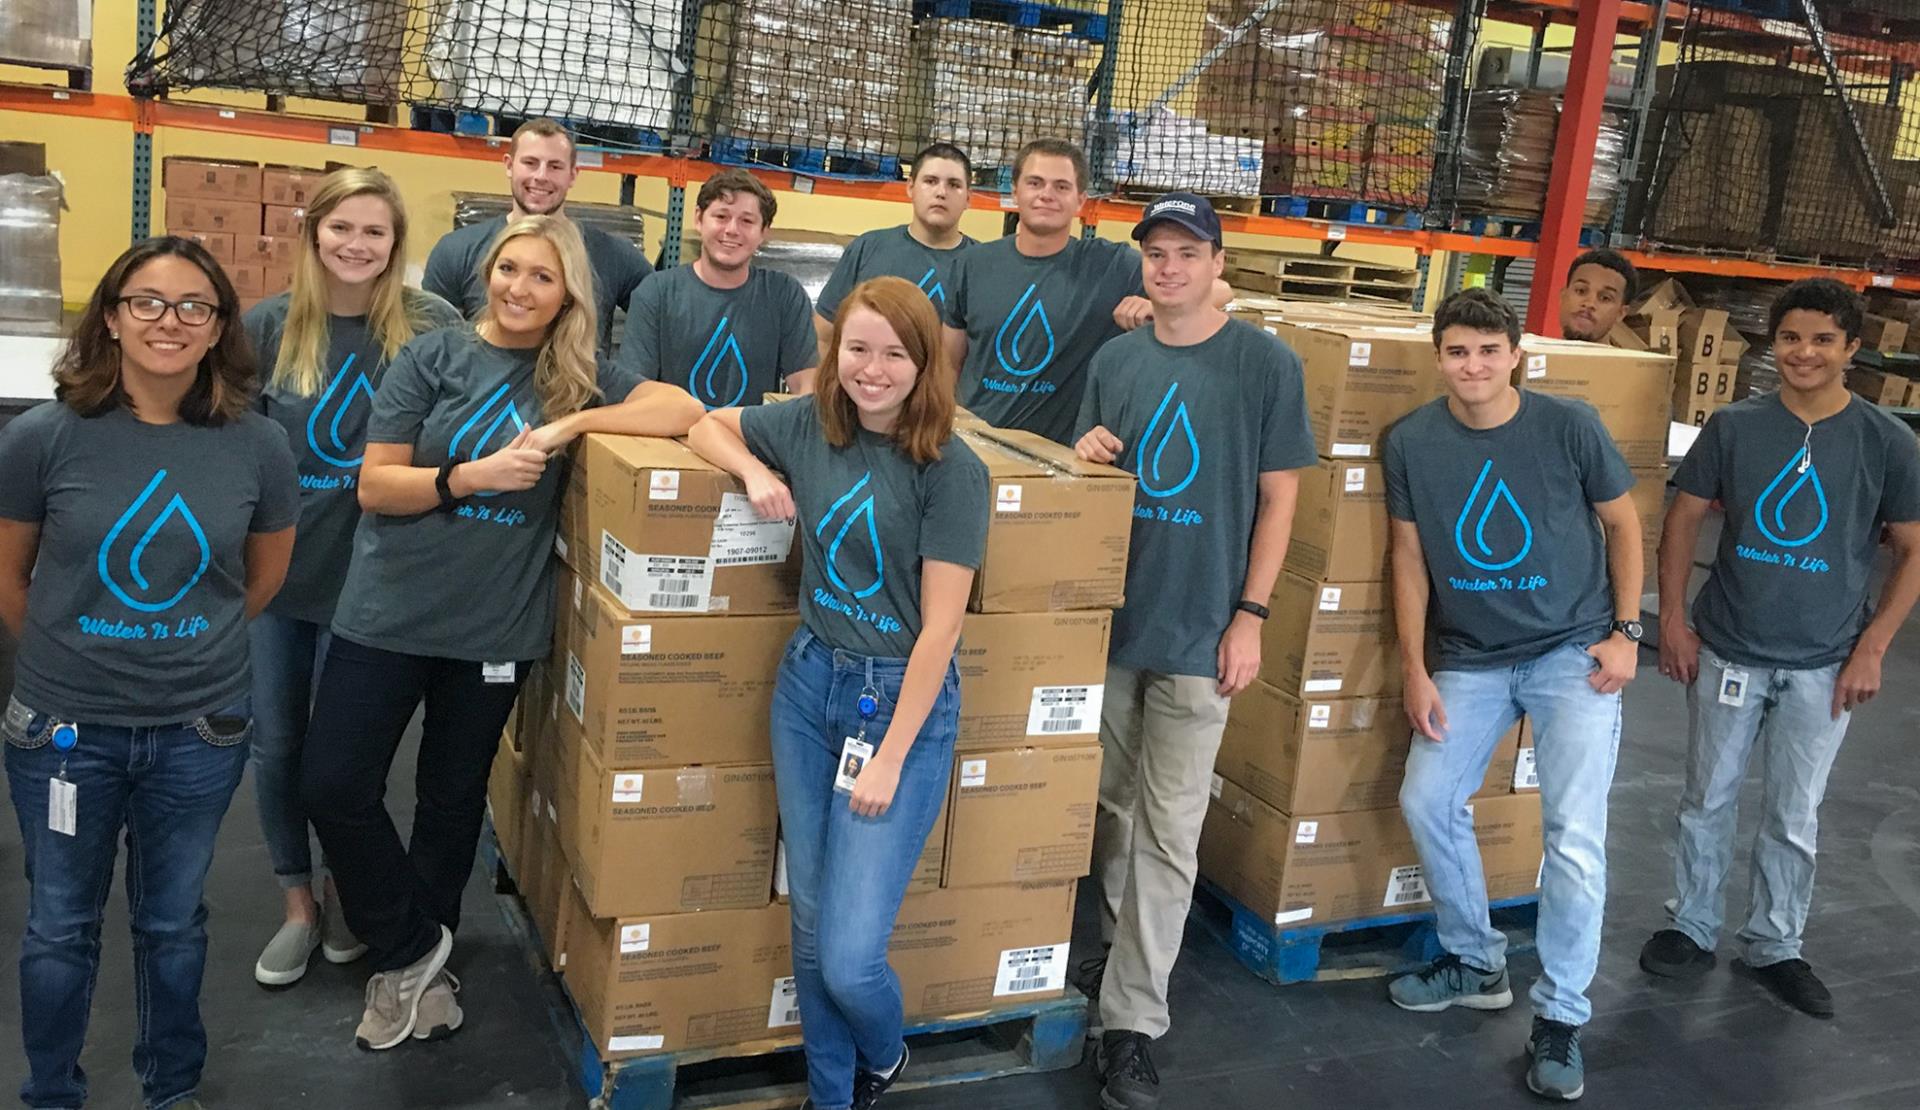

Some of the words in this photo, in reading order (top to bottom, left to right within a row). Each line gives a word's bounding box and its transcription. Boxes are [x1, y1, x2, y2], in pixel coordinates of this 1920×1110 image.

[1702, 334, 1714, 357] B
[982, 377, 1020, 393] Water
[1030, 380, 1057, 393] Life
[1697, 372, 1709, 395] B
[1718, 372, 1729, 395] B
[298, 474, 340, 489] Water
[477, 505, 491, 520] Is
[494, 506, 526, 527] Life
[648, 503, 693, 513] SEASONED
[1156, 506, 1169, 521] Is
[1171, 508, 1203, 526] Life
[727, 546, 767, 555] 1907-09012
[1735, 544, 1780, 564] Water
[1783, 553, 1796, 567] Is
[1799, 556, 1831, 573] Life
[1448, 576, 1497, 591] Water
[1499, 576, 1513, 590] Is
[1517, 575, 1548, 591] Life
[78, 615, 147, 640] Water
[152, 622, 170, 640] Is
[174, 615, 210, 639] Life
[620, 652, 665, 662] SEASONED
[667, 652, 702, 661] COOKED
[703, 651, 725, 661] BEEF
[1000, 784, 1028, 792] COOKED
[612, 807, 658, 816] SEASONED
[659, 805, 694, 814] COOKED
[695, 803, 716, 812] BEEF
[620, 950, 665, 962] SEASONED
[665, 946, 701, 957] COOKED
[701, 943, 722, 953] BEEF
